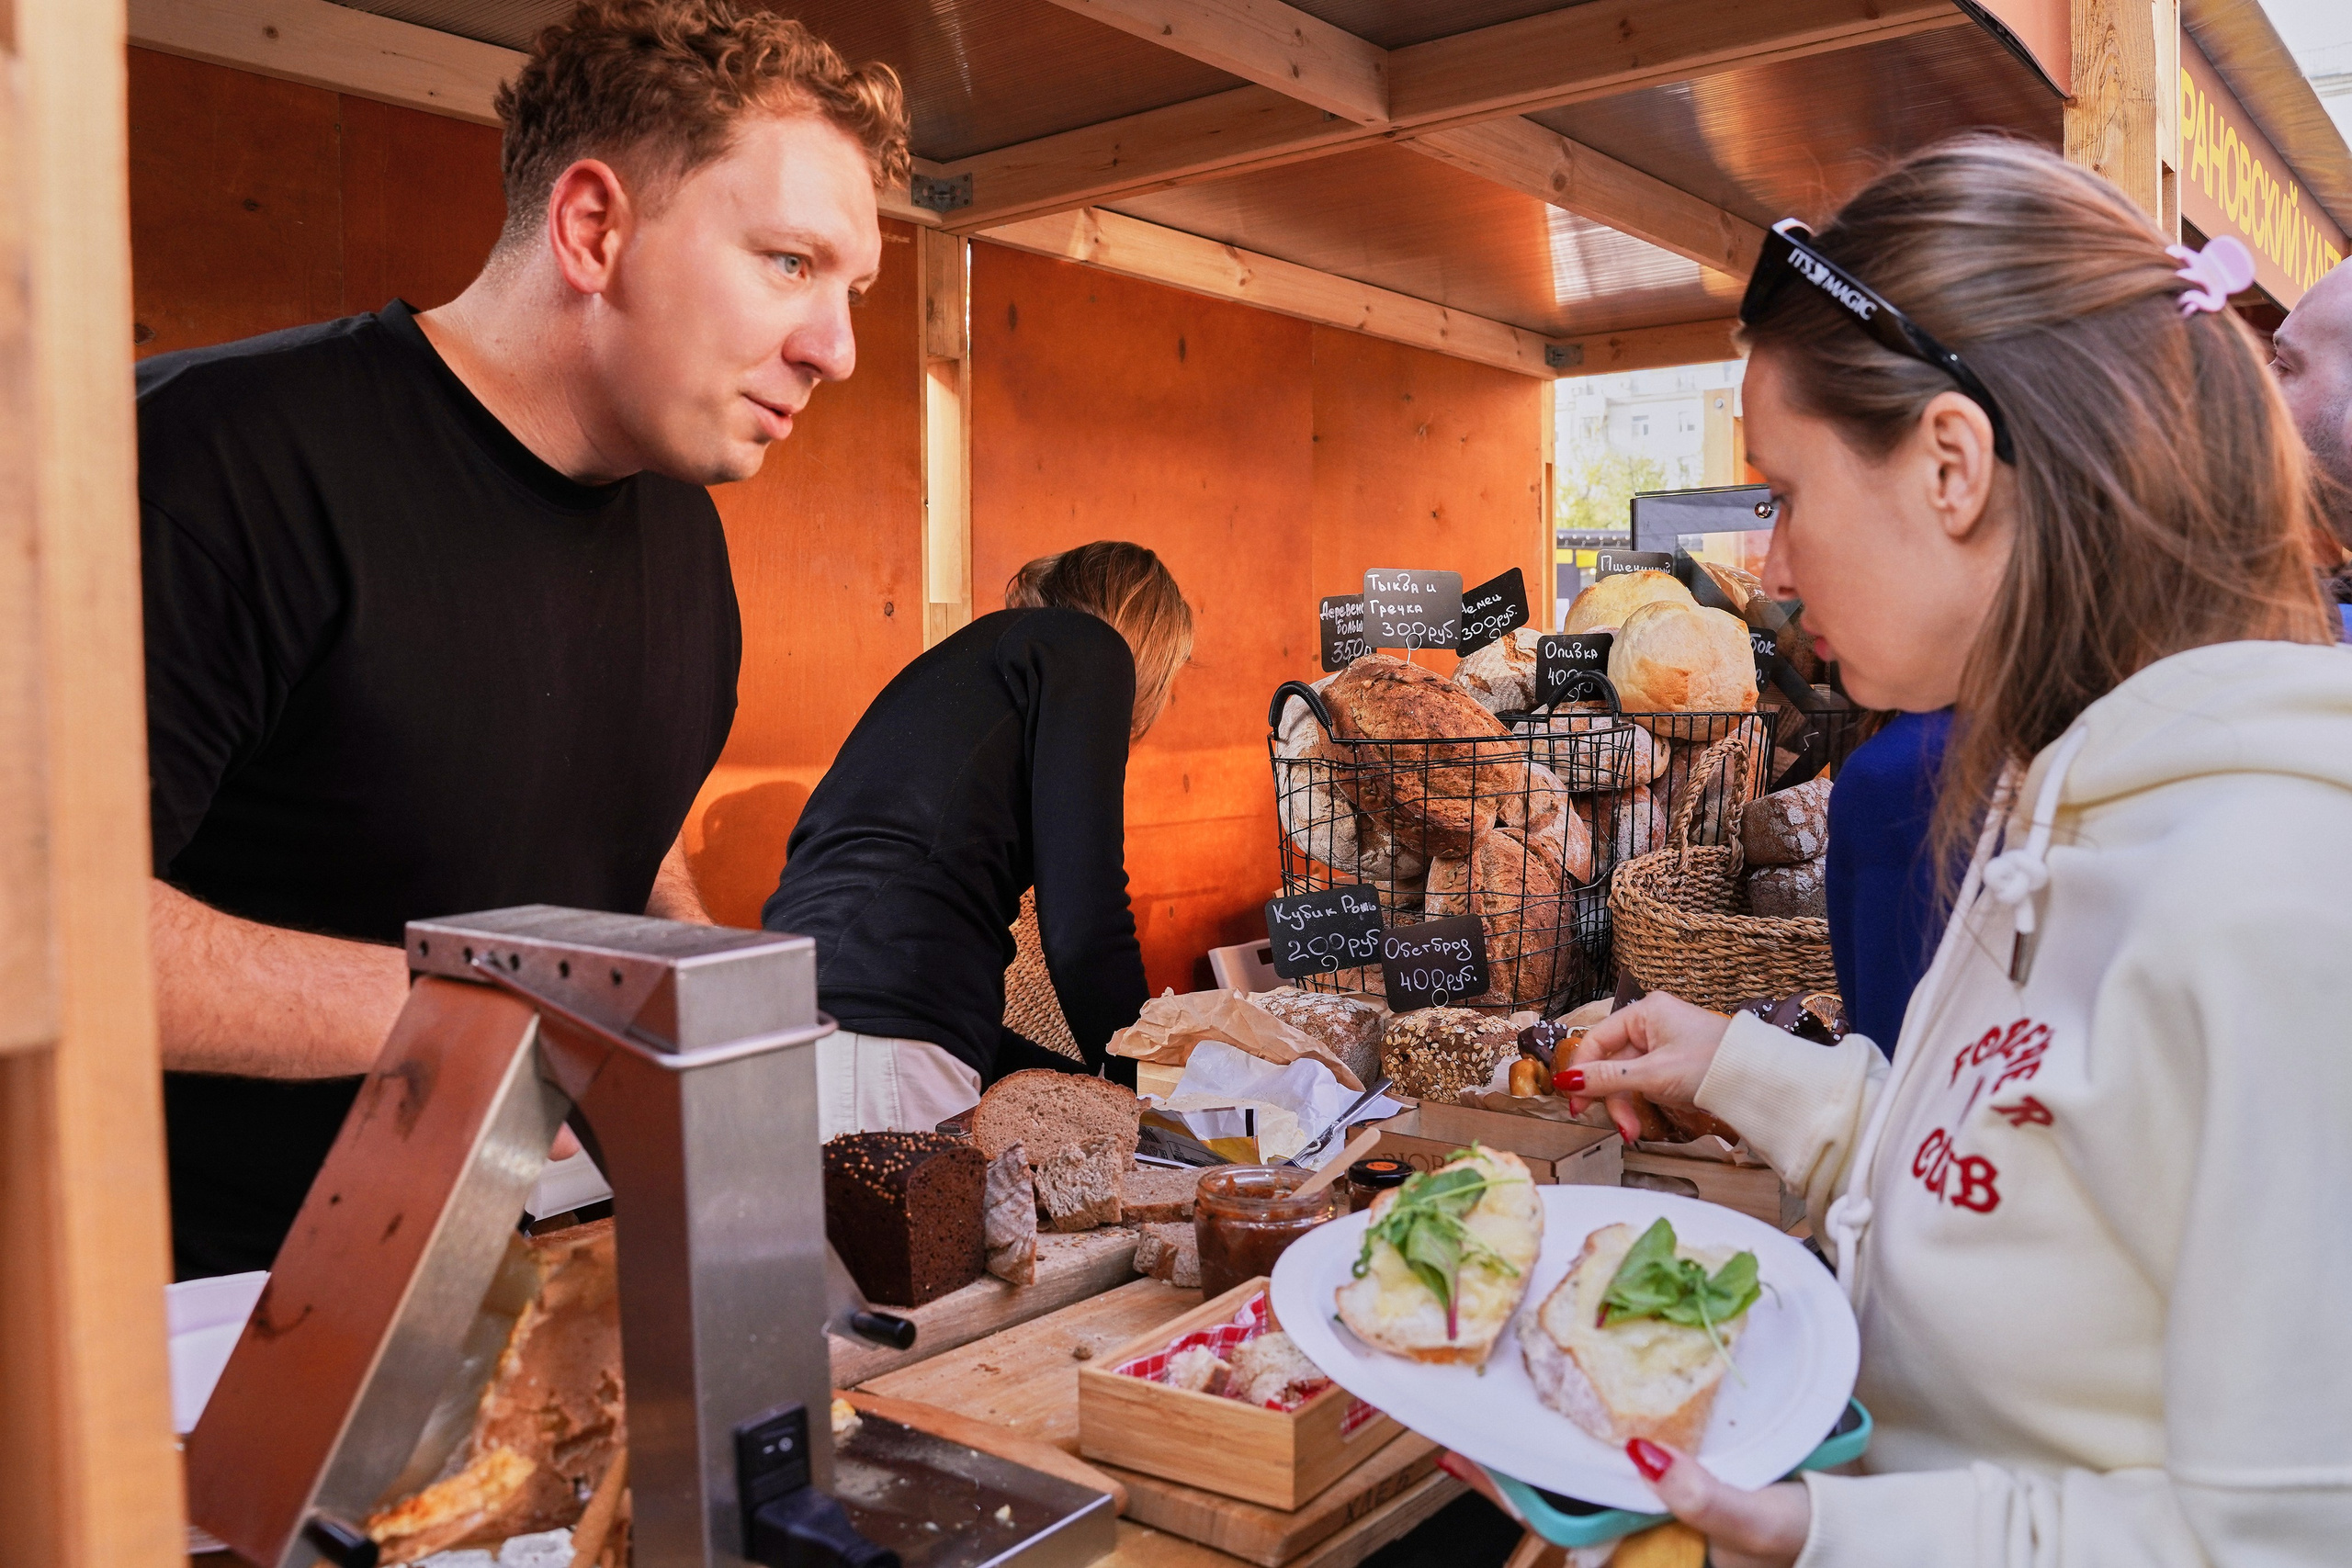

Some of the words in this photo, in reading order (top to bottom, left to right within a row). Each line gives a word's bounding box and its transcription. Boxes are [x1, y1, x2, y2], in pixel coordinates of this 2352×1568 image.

[1821, 275, 1878, 321] MAGIC
[1367, 573, 1419, 593] Тыква
[1427, 583, 1437, 593] и
[1370, 600, 1423, 617] Гречка
[1545, 641, 1599, 660] Оливка
[1272, 902, 1338, 931] Кубик
